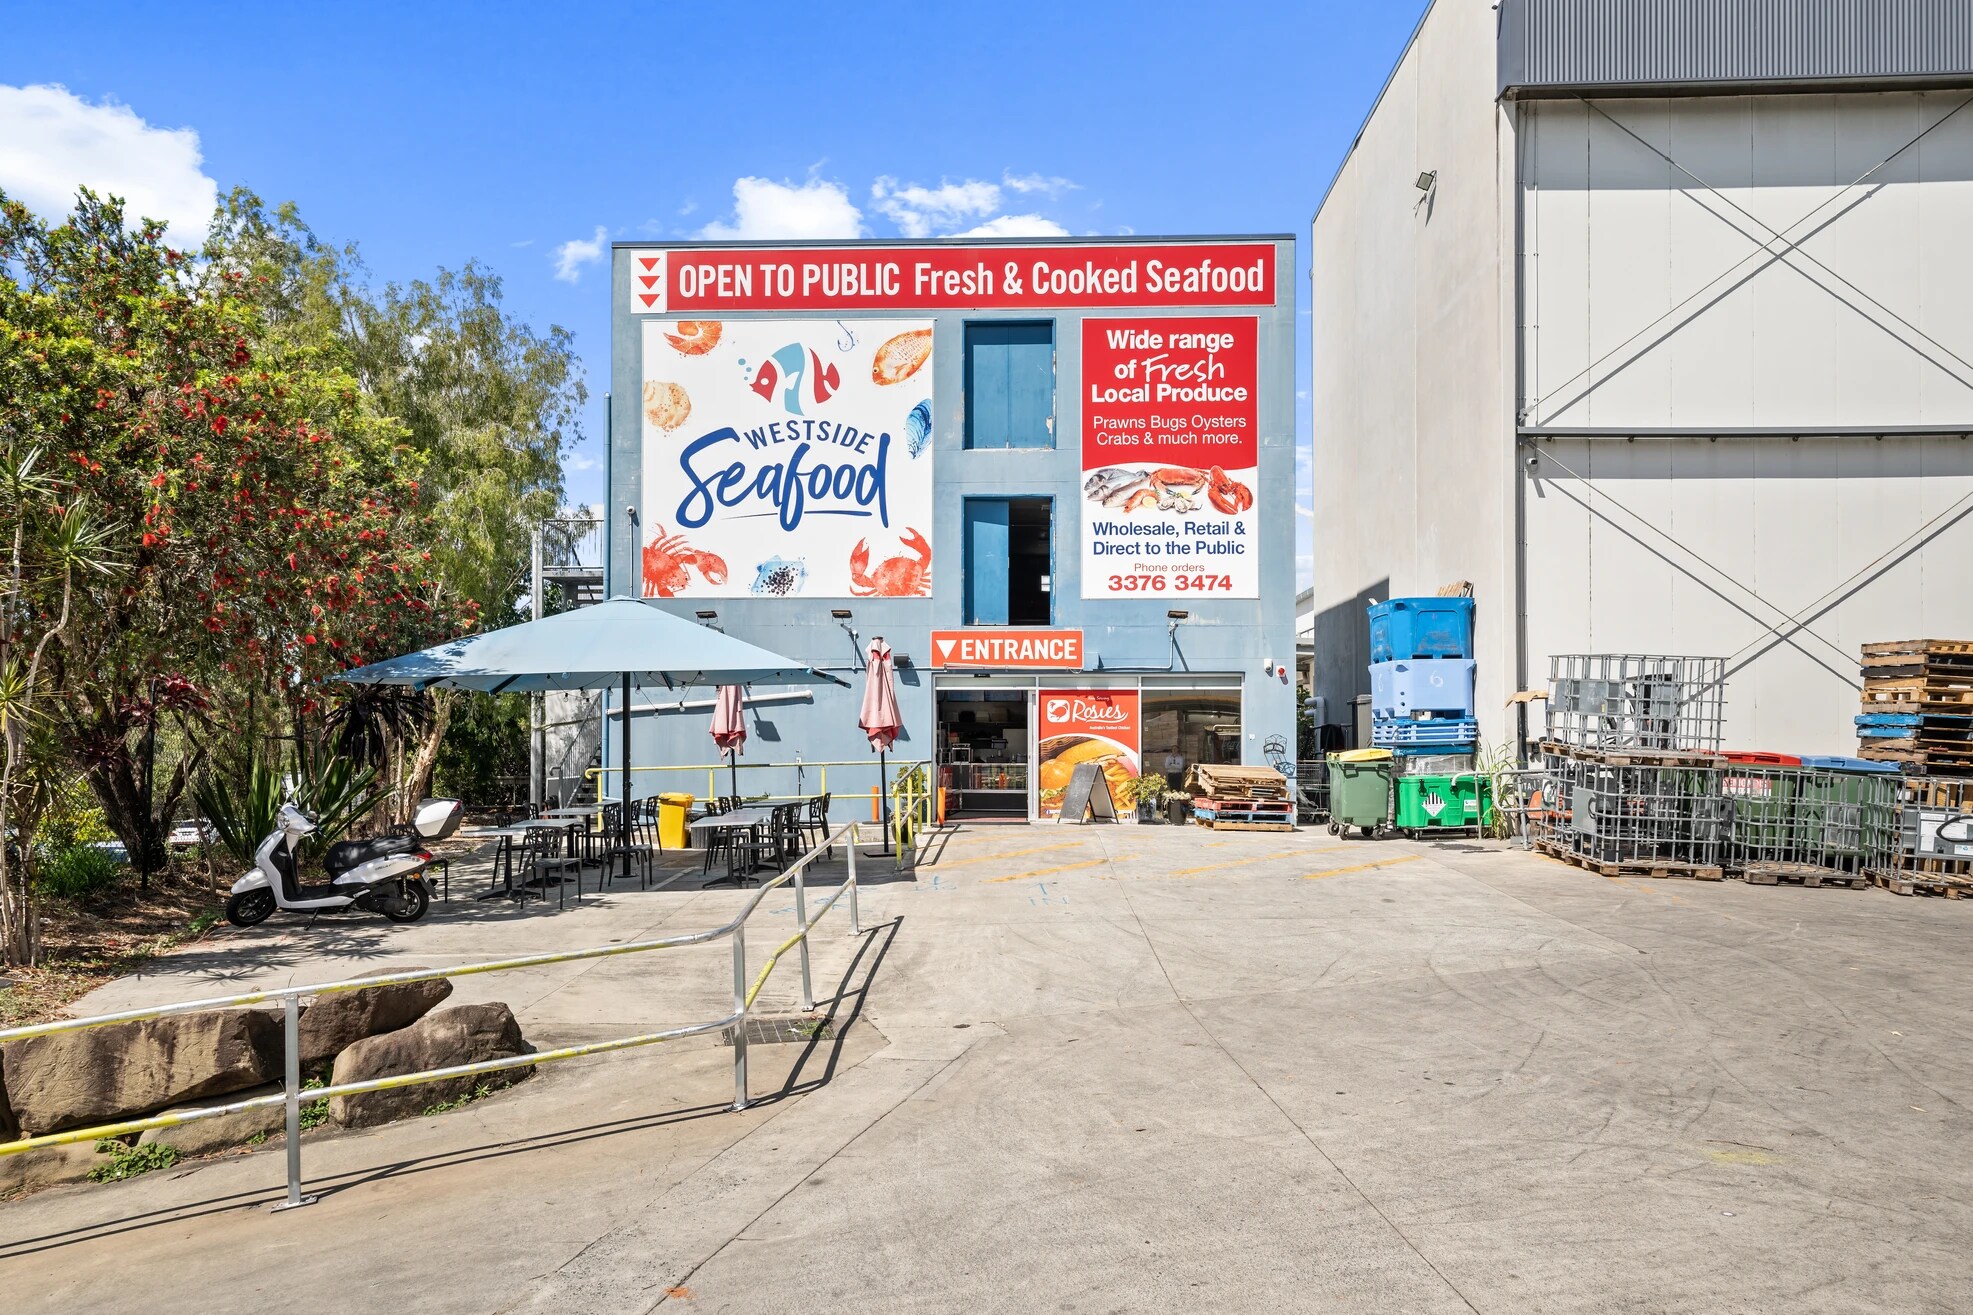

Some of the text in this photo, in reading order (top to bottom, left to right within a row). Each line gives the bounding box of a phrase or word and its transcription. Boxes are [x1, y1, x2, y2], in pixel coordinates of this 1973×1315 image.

[679, 258, 1264, 298] OPEN TO PUBLIC Fresh & Cooked Seafood
[1106, 329, 1235, 353] Wide range
[1114, 353, 1225, 383] of Fresh
[1091, 382, 1248, 403] Local Produce
[1093, 414, 1247, 431] Prawns Bugs Oysters
[743, 419, 875, 455] WESTSIDE
[1096, 431, 1243, 445] Crabs & much more.
[675, 426, 891, 532] Seafood
[1092, 521, 1246, 538] Wholesale, Retail &
[1093, 540, 1245, 555] Direct to the Public
[1134, 562, 1205, 572] Phone orders
[1108, 574, 1232, 592] 3376 3474
[961, 638, 1077, 660] ENTRANCE
[1072, 699, 1128, 723] Rosies
